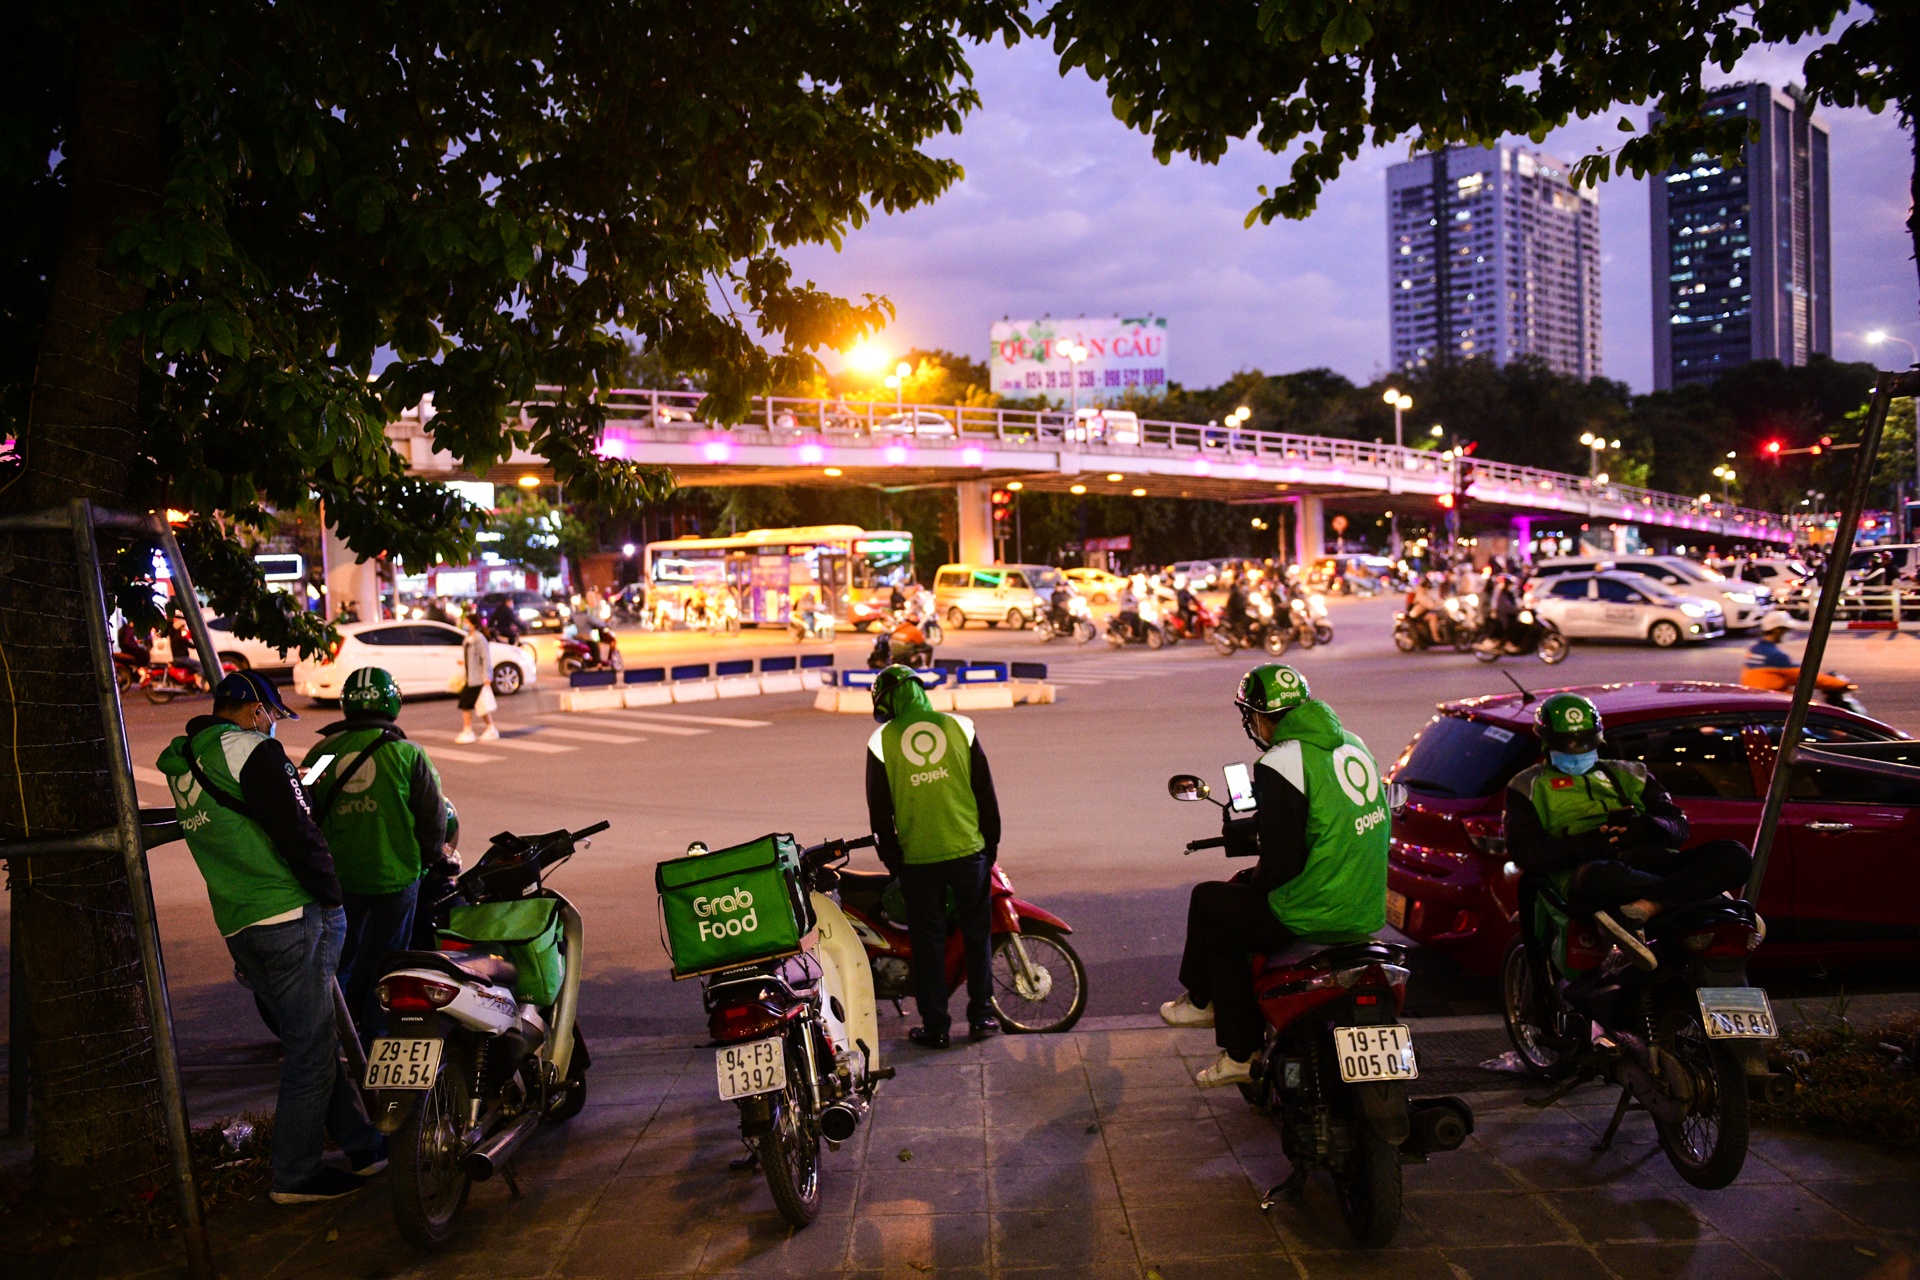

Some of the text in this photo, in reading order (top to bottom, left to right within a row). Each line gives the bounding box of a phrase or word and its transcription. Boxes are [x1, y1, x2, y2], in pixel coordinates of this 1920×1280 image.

[349, 687, 380, 701] Grab
[1280, 689, 1301, 699] gojek
[910, 767, 949, 786] gojek
[337, 795, 378, 815] Grab
[1355, 805, 1386, 835] gojek
[693, 886, 753, 917] Grab
[698, 907, 758, 942] Food
[378, 1041, 431, 1062] 29-E1
[1347, 1029, 1400, 1052] 19-F1
[726, 1042, 773, 1071] 94-F3
[368, 1063, 430, 1085] 816.54
[728, 1066, 776, 1095] 1392
